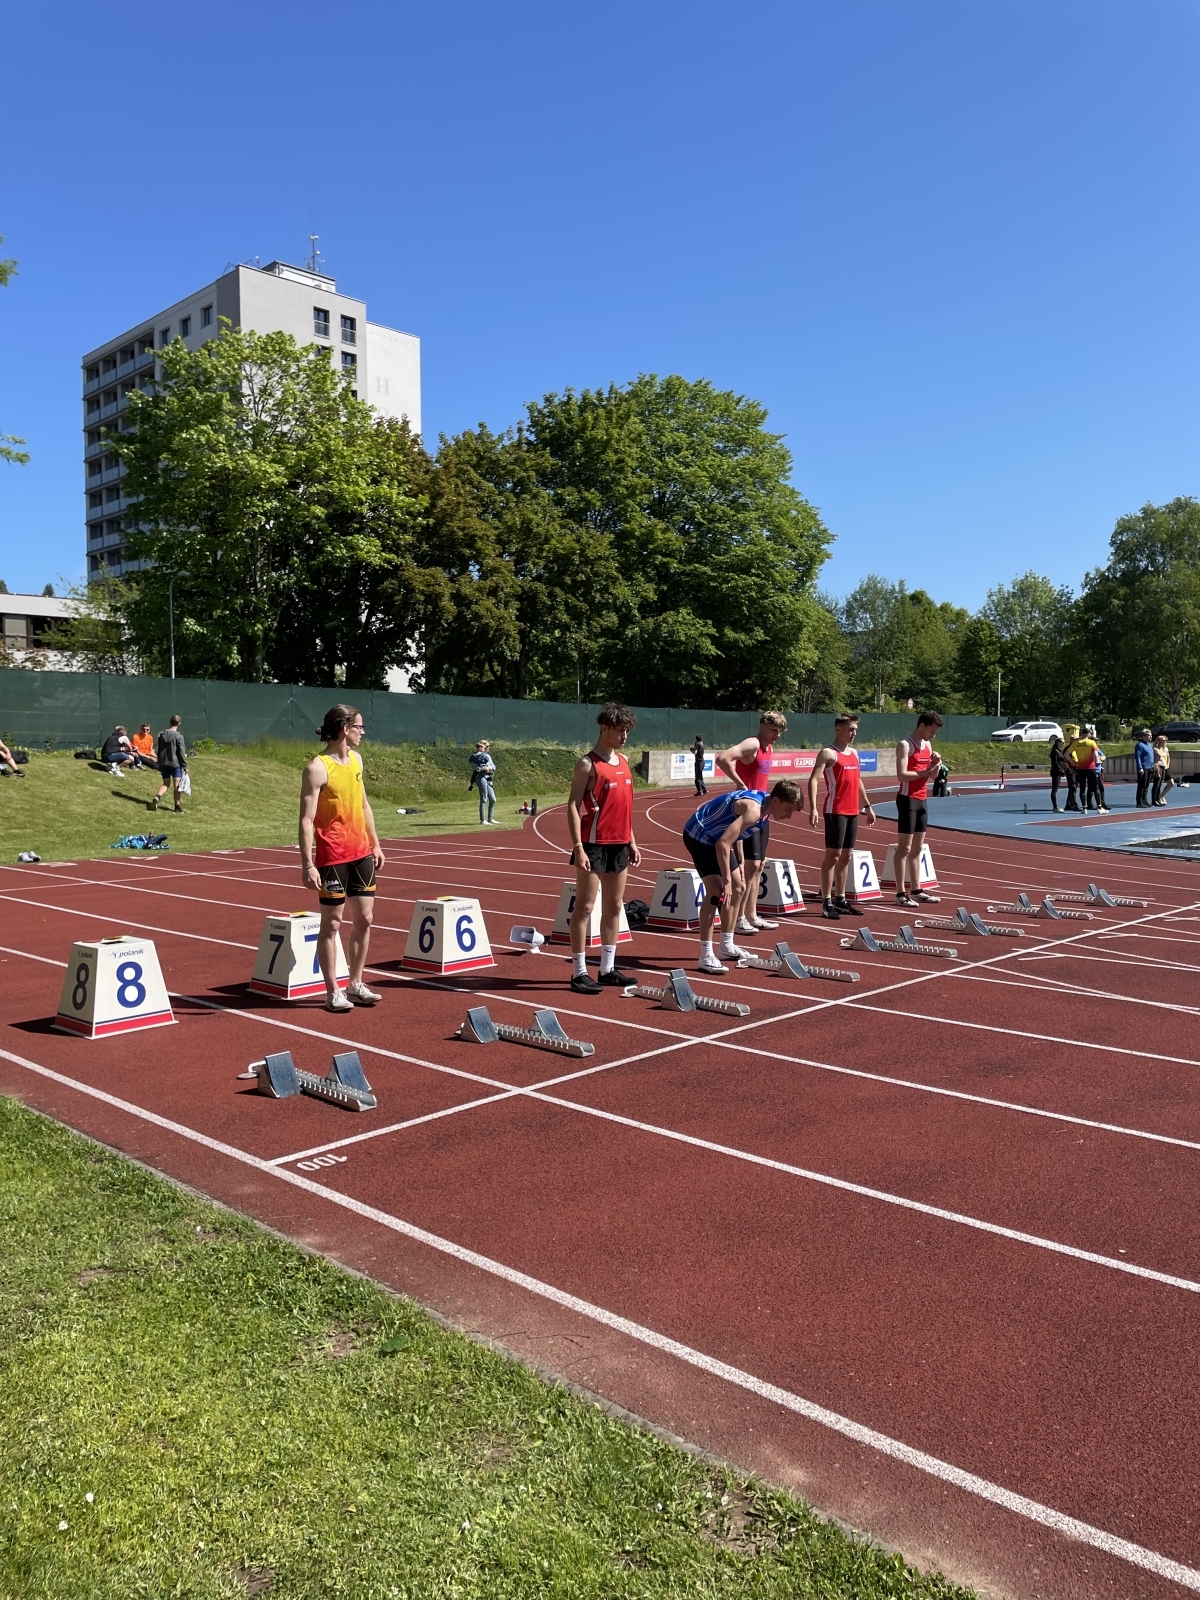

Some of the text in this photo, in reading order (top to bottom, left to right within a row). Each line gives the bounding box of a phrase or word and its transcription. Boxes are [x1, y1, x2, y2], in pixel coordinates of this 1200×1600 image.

[860, 861, 872, 887] 2
[921, 853, 929, 877] 1
[661, 883, 678, 913] 4
[757, 872, 768, 899] 3
[782, 871, 794, 898] 3
[418, 915, 436, 953] 6
[455, 914, 476, 952] 6
[119, 948, 145, 958] polanik
[267, 933, 284, 974] 7
[304, 933, 320, 974] 7
[72, 962, 90, 1011] 8
[116, 961, 147, 1008] 8
[296, 1153, 348, 1171] 100
